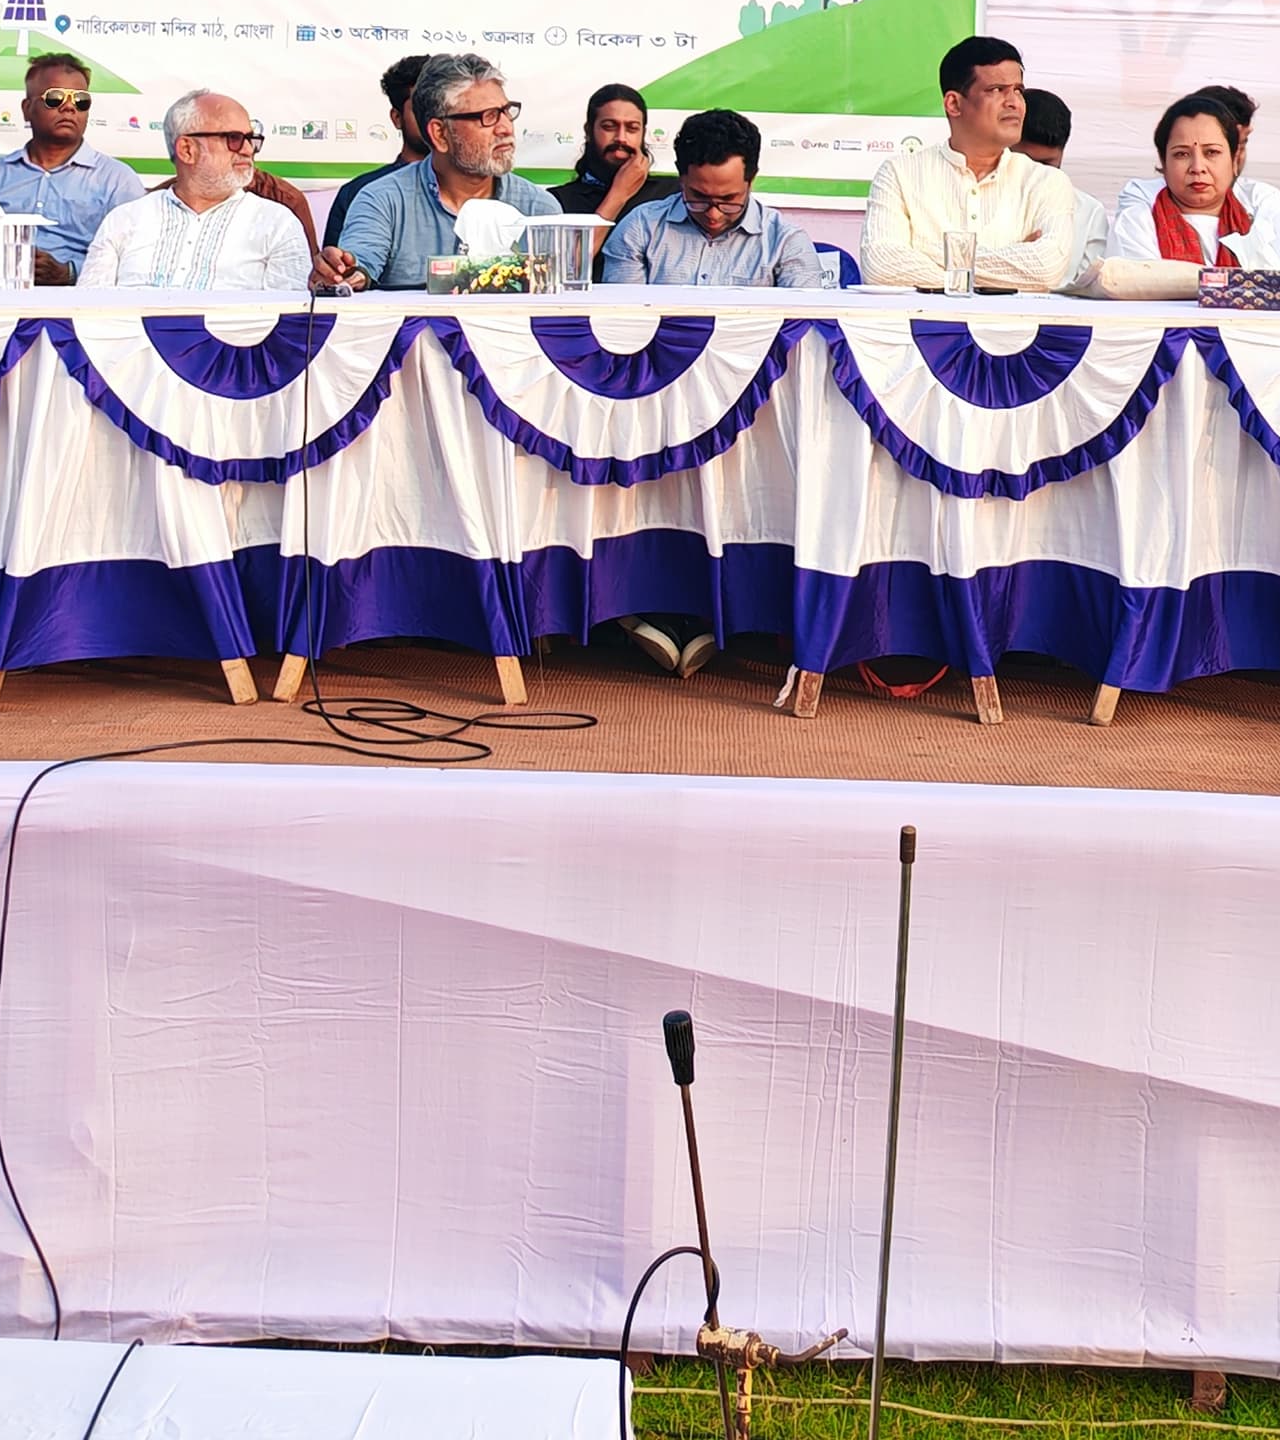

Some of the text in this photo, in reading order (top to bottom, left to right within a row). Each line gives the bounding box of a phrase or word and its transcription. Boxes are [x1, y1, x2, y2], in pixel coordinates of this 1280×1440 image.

[76, 15, 156, 36] নারিকেলতলা
[160, 17, 196, 37] মন্দির
[233, 23, 275, 40] মোংলা
[320, 27, 343, 40] ২৩
[576, 28, 698, 50] বিকেল ৩ টা
